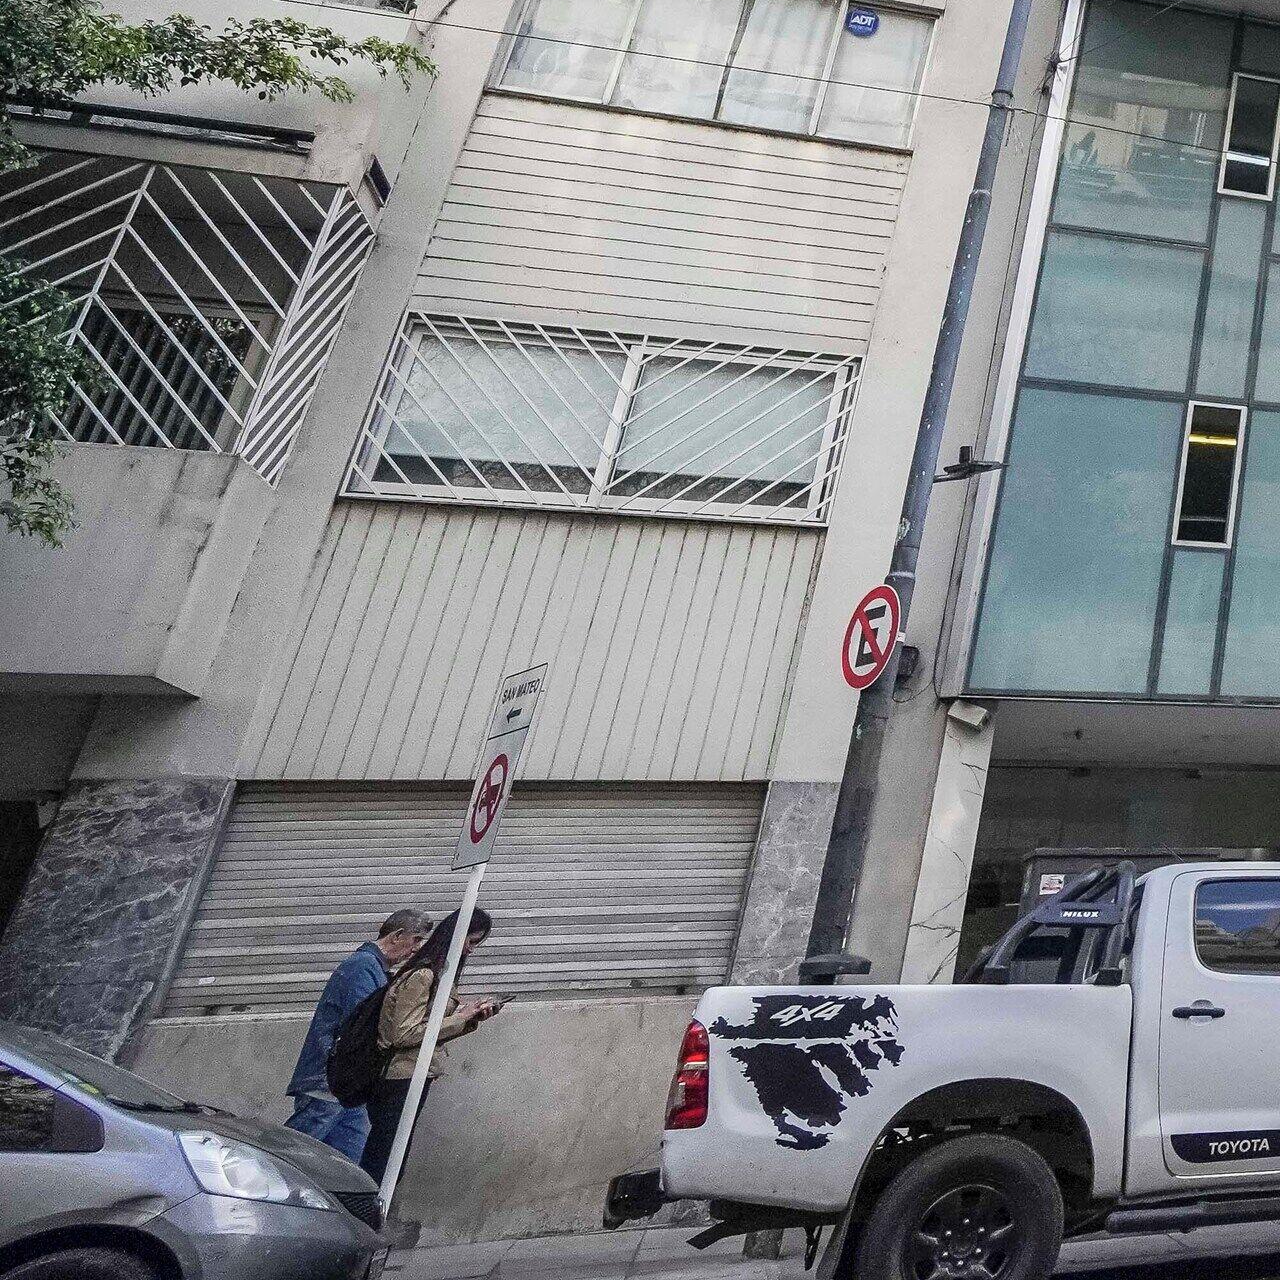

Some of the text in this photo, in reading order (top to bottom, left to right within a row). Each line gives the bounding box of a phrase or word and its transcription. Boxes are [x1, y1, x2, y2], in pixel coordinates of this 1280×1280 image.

[851, 15, 875, 26] ADT
[502, 679, 540, 704] SAN MATEO
[1209, 1138, 1270, 1155] TOYOTA
